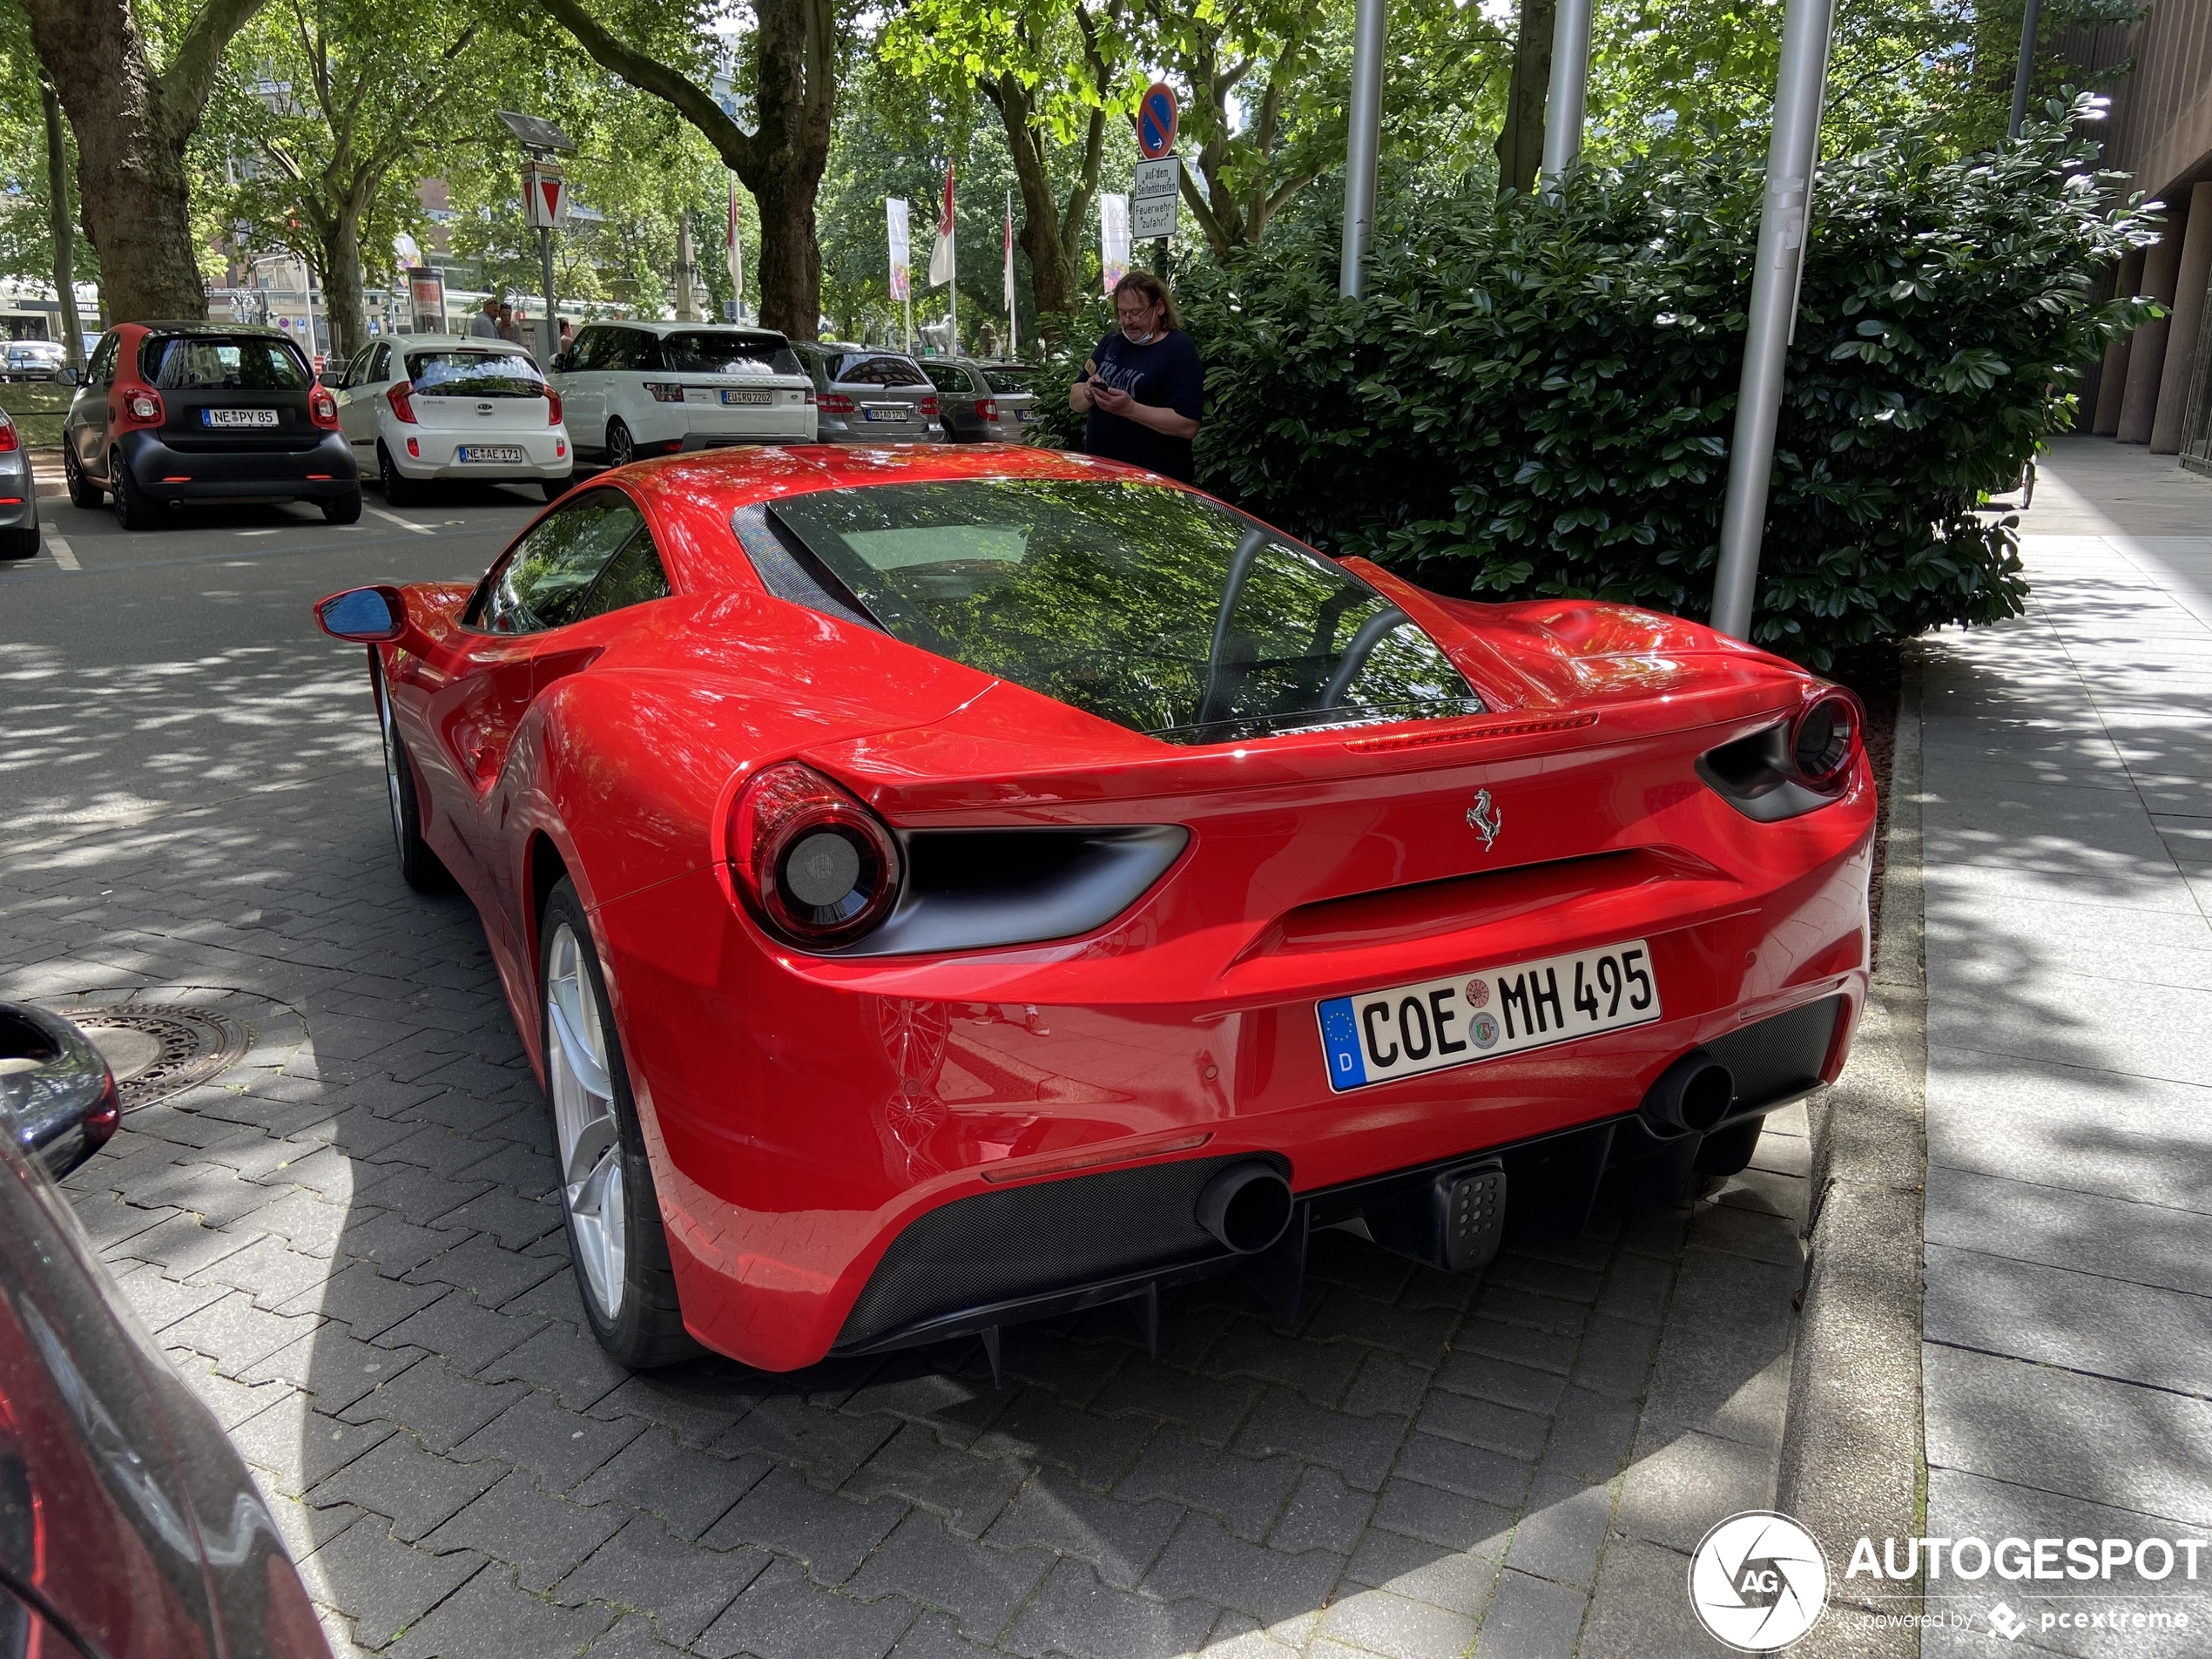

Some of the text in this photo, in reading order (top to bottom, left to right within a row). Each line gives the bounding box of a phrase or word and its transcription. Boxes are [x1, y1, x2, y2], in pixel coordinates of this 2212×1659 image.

[1144, 167, 1169, 179] auf dem
[1137, 181, 1176, 195] Seitenstreifen
[1136, 202, 1174, 216] Feuerwehr-
[1142, 217, 1167, 229] zufahrt
[727, 394, 738, 402] EU
[214, 412, 273, 422] NE PY 85
[466, 449, 520, 459] NE AE 171
[1363, 988, 1467, 1068] COE
[1497, 968, 1564, 1040] MH
[1574, 949, 1651, 1022] 495
[1339, 1052, 1352, 1072] D
